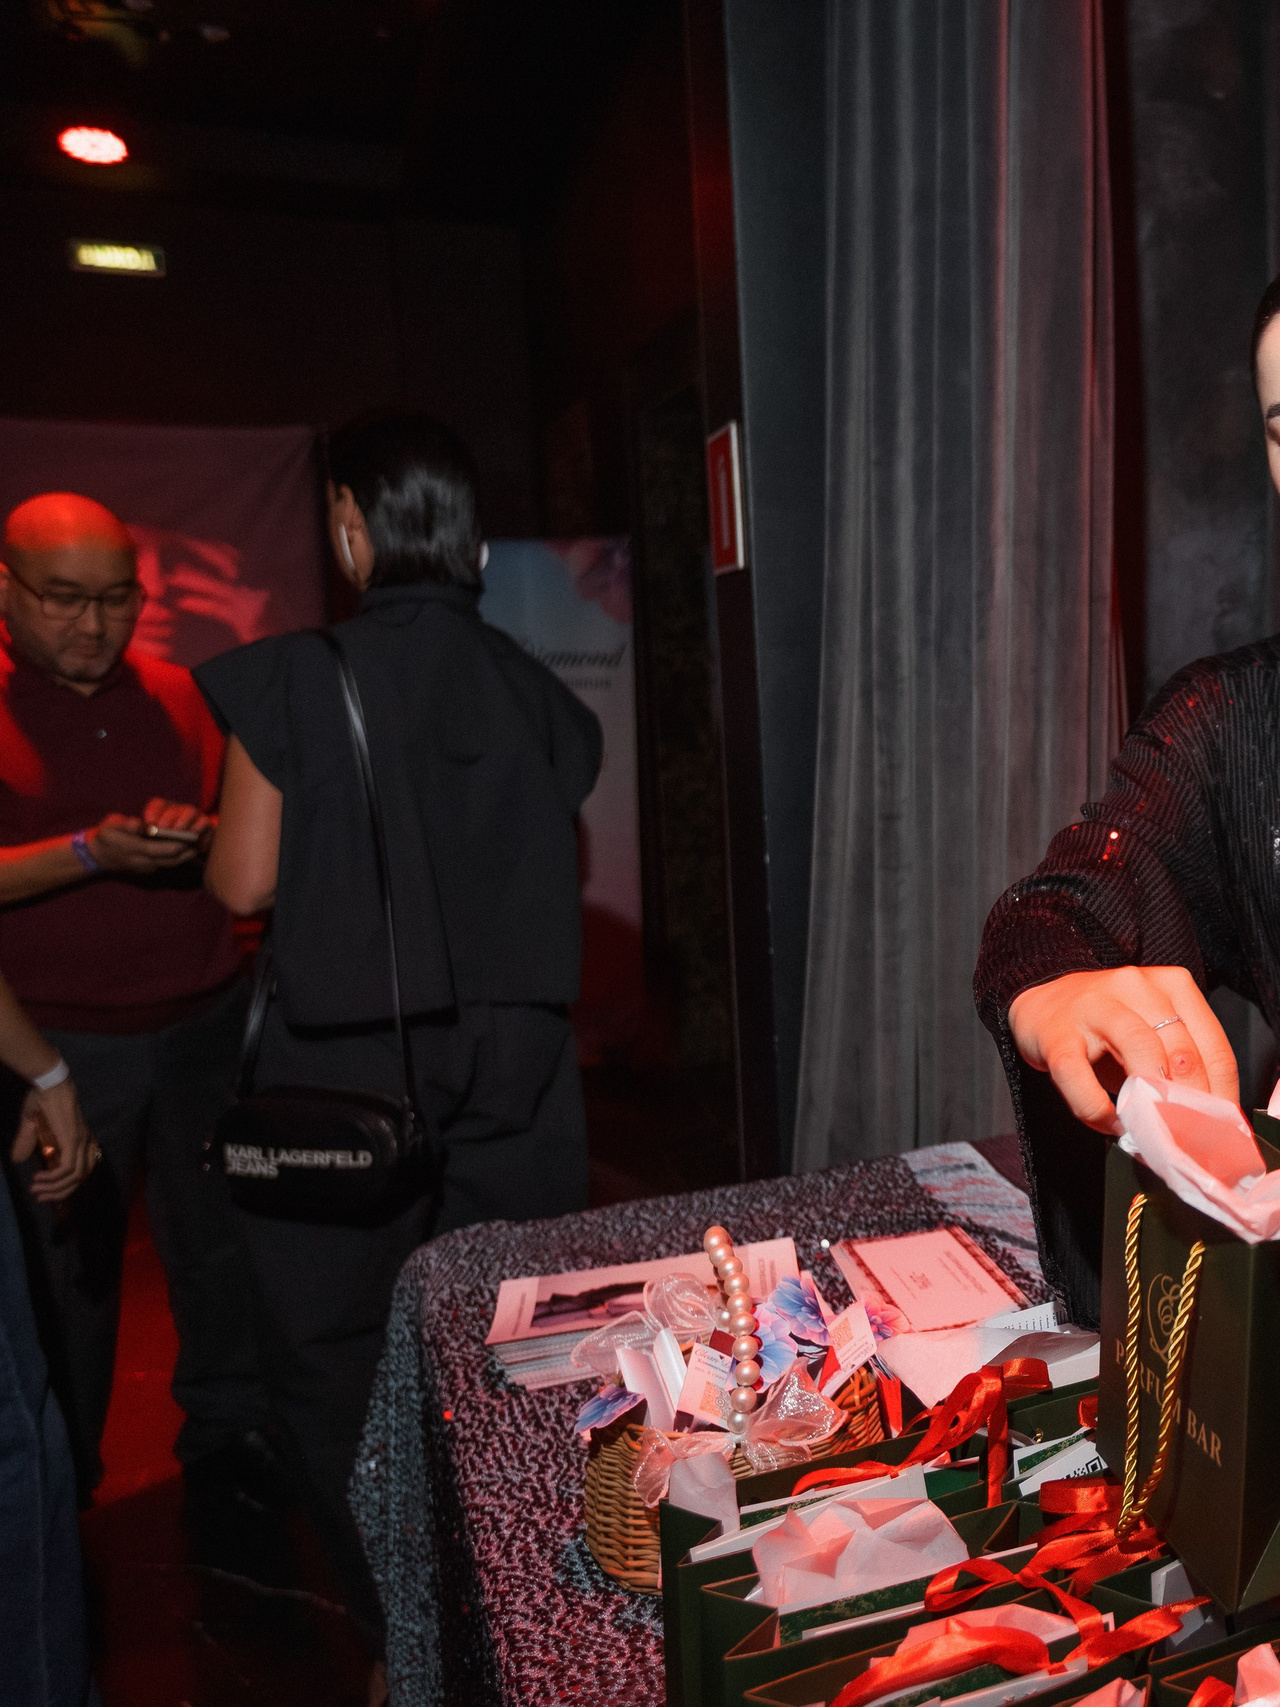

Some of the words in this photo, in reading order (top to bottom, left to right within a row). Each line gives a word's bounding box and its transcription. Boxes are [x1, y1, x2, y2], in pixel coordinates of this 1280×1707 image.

[225, 1143, 265, 1160] KARL
[269, 1148, 373, 1169] LAGERFELD
[226, 1159, 278, 1178] JEANS
[1115, 1338, 1181, 1424] PRFUM
[1187, 1408, 1222, 1467] BAR
